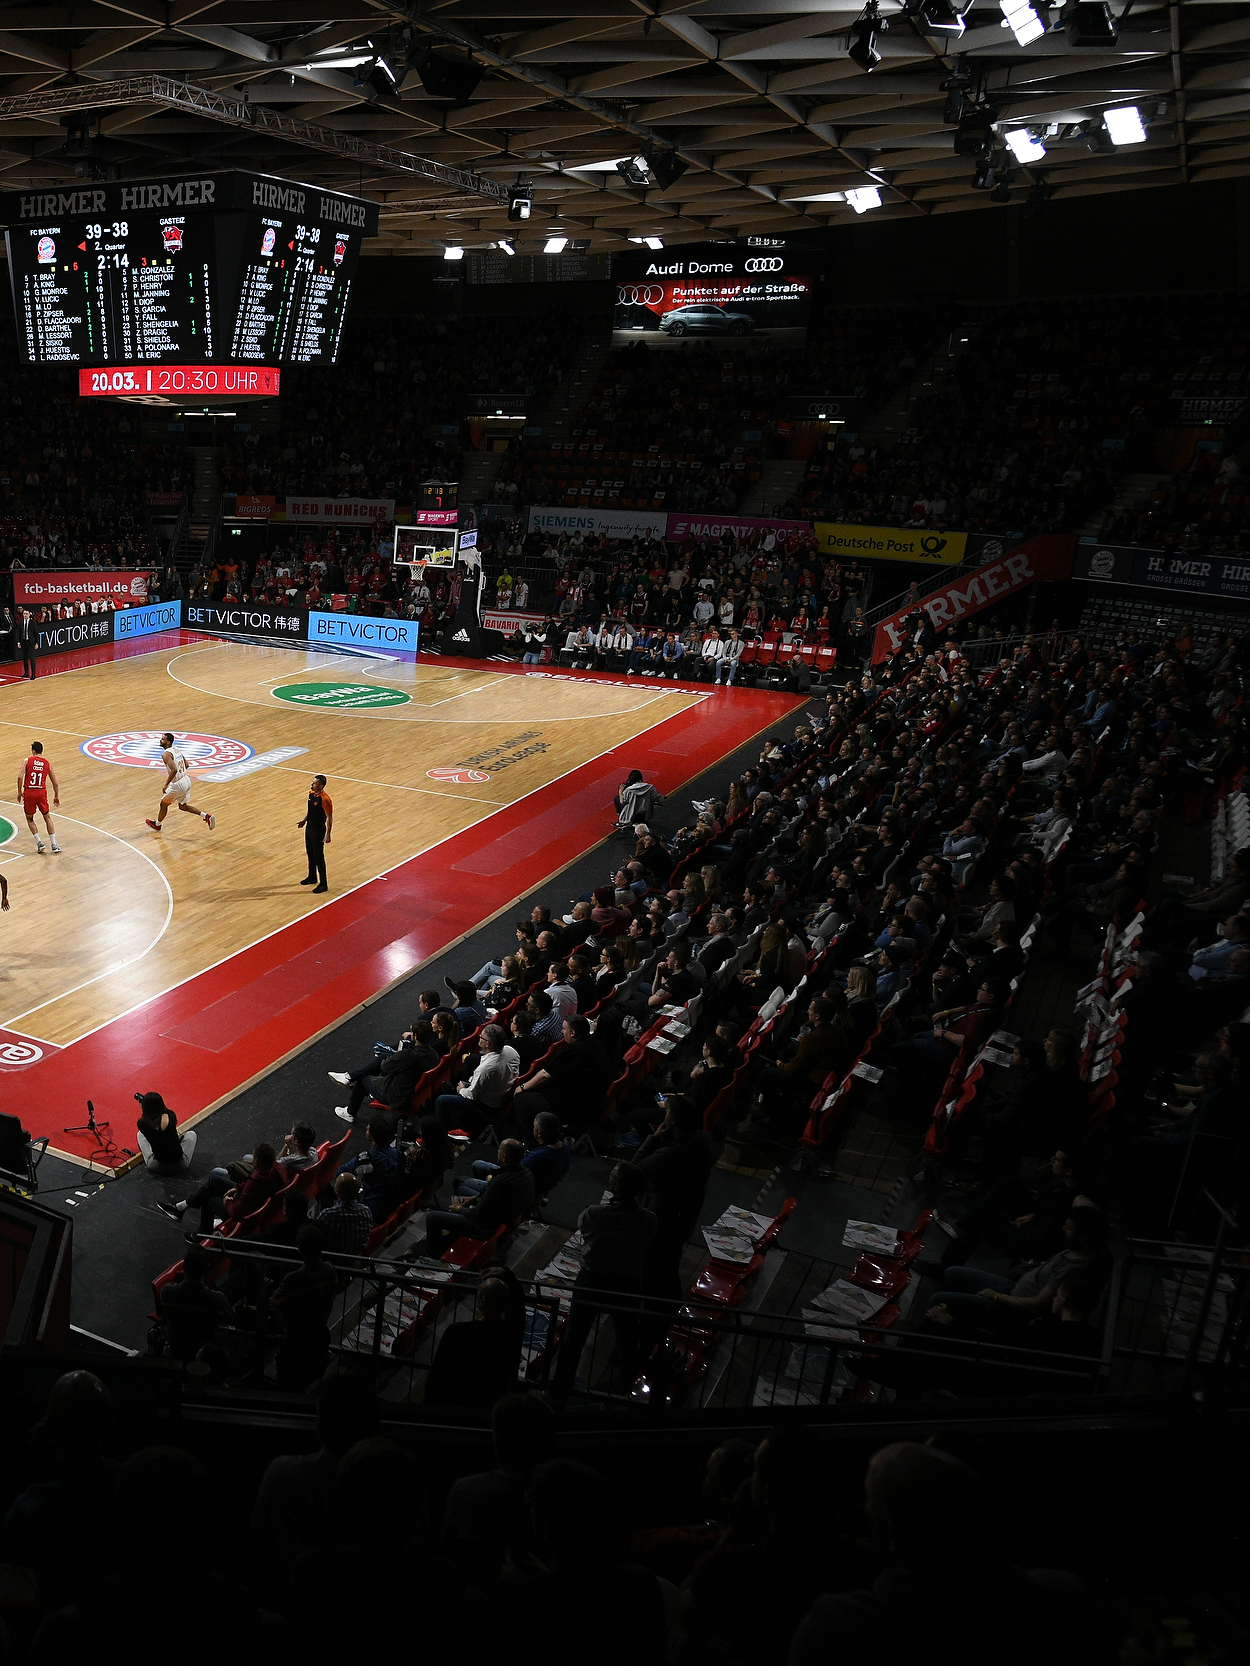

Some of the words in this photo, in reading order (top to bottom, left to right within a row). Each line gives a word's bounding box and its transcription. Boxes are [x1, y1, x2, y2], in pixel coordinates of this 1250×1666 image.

[19, 189, 107, 218] HIRMER
[120, 179, 216, 211] HIRMER
[252, 180, 306, 215] HIRMER
[319, 196, 366, 228] HIRMER
[159, 217, 186, 225] GASTEIZ
[38, 227, 61, 236] BAYERN
[73, 261, 78, 271] 5
[97, 253, 129, 270] 2:14
[141, 257, 147, 266] 3
[140, 265, 175, 275] GONZALEZ
[645, 262, 684, 275] Audi
[688, 261, 734, 274] Dome
[139, 273, 174, 282] CHRISTON
[40, 280, 55, 288] KING
[140, 282, 163, 290] HENRY
[41, 287, 69, 295] MONROE
[141, 289, 170, 298] JANNING
[672, 286, 718, 296] Punktet
[720, 285, 741, 294] auf
[742, 285, 763, 294] der
[765, 283, 808, 293] Straße.
[41, 295, 60, 303] LUCIC
[766, 294, 800, 302] Sportback.
[141, 305, 167, 313] GARCIA
[142, 313, 158, 321] FALL
[44, 324, 71, 332] BARTHEL
[143, 328, 168, 336] DRAGIC
[45, 331, 73, 339] LESSORT
[143, 336, 171, 344] SHIELDS
[144, 343, 180, 351] POLONARA
[145, 351, 162, 359] ERIC
[91, 371, 140, 391] 20.03.
[158, 371, 218, 390] 20:30
[224, 371, 258, 390] UHR
[238, 505, 271, 514] BIGREDS
[291, 502, 319, 516] RED
[533, 515, 595, 528] SIEMENS
[597, 521, 633, 535] Ingenuity
[827, 533, 884, 551] Deutsche
[886, 539, 915, 553] Post
[1146, 574, 1173, 584] GROSSE
[24, 581, 129, 594] fcb-basketball.de
[883, 552, 1035, 650] HRMER
[120, 607, 176, 633] BETVICTOR
[188, 606, 272, 629] BETVICTOR
[484, 618, 520, 631] BAVARIA
[317, 619, 408, 643] BETVICTOR
[38, 624, 88, 649] TVICTOR
[451, 634, 471, 643] adidas
[206, 747, 303, 780] BASKETBALL
[29, 772, 43, 786] 31
